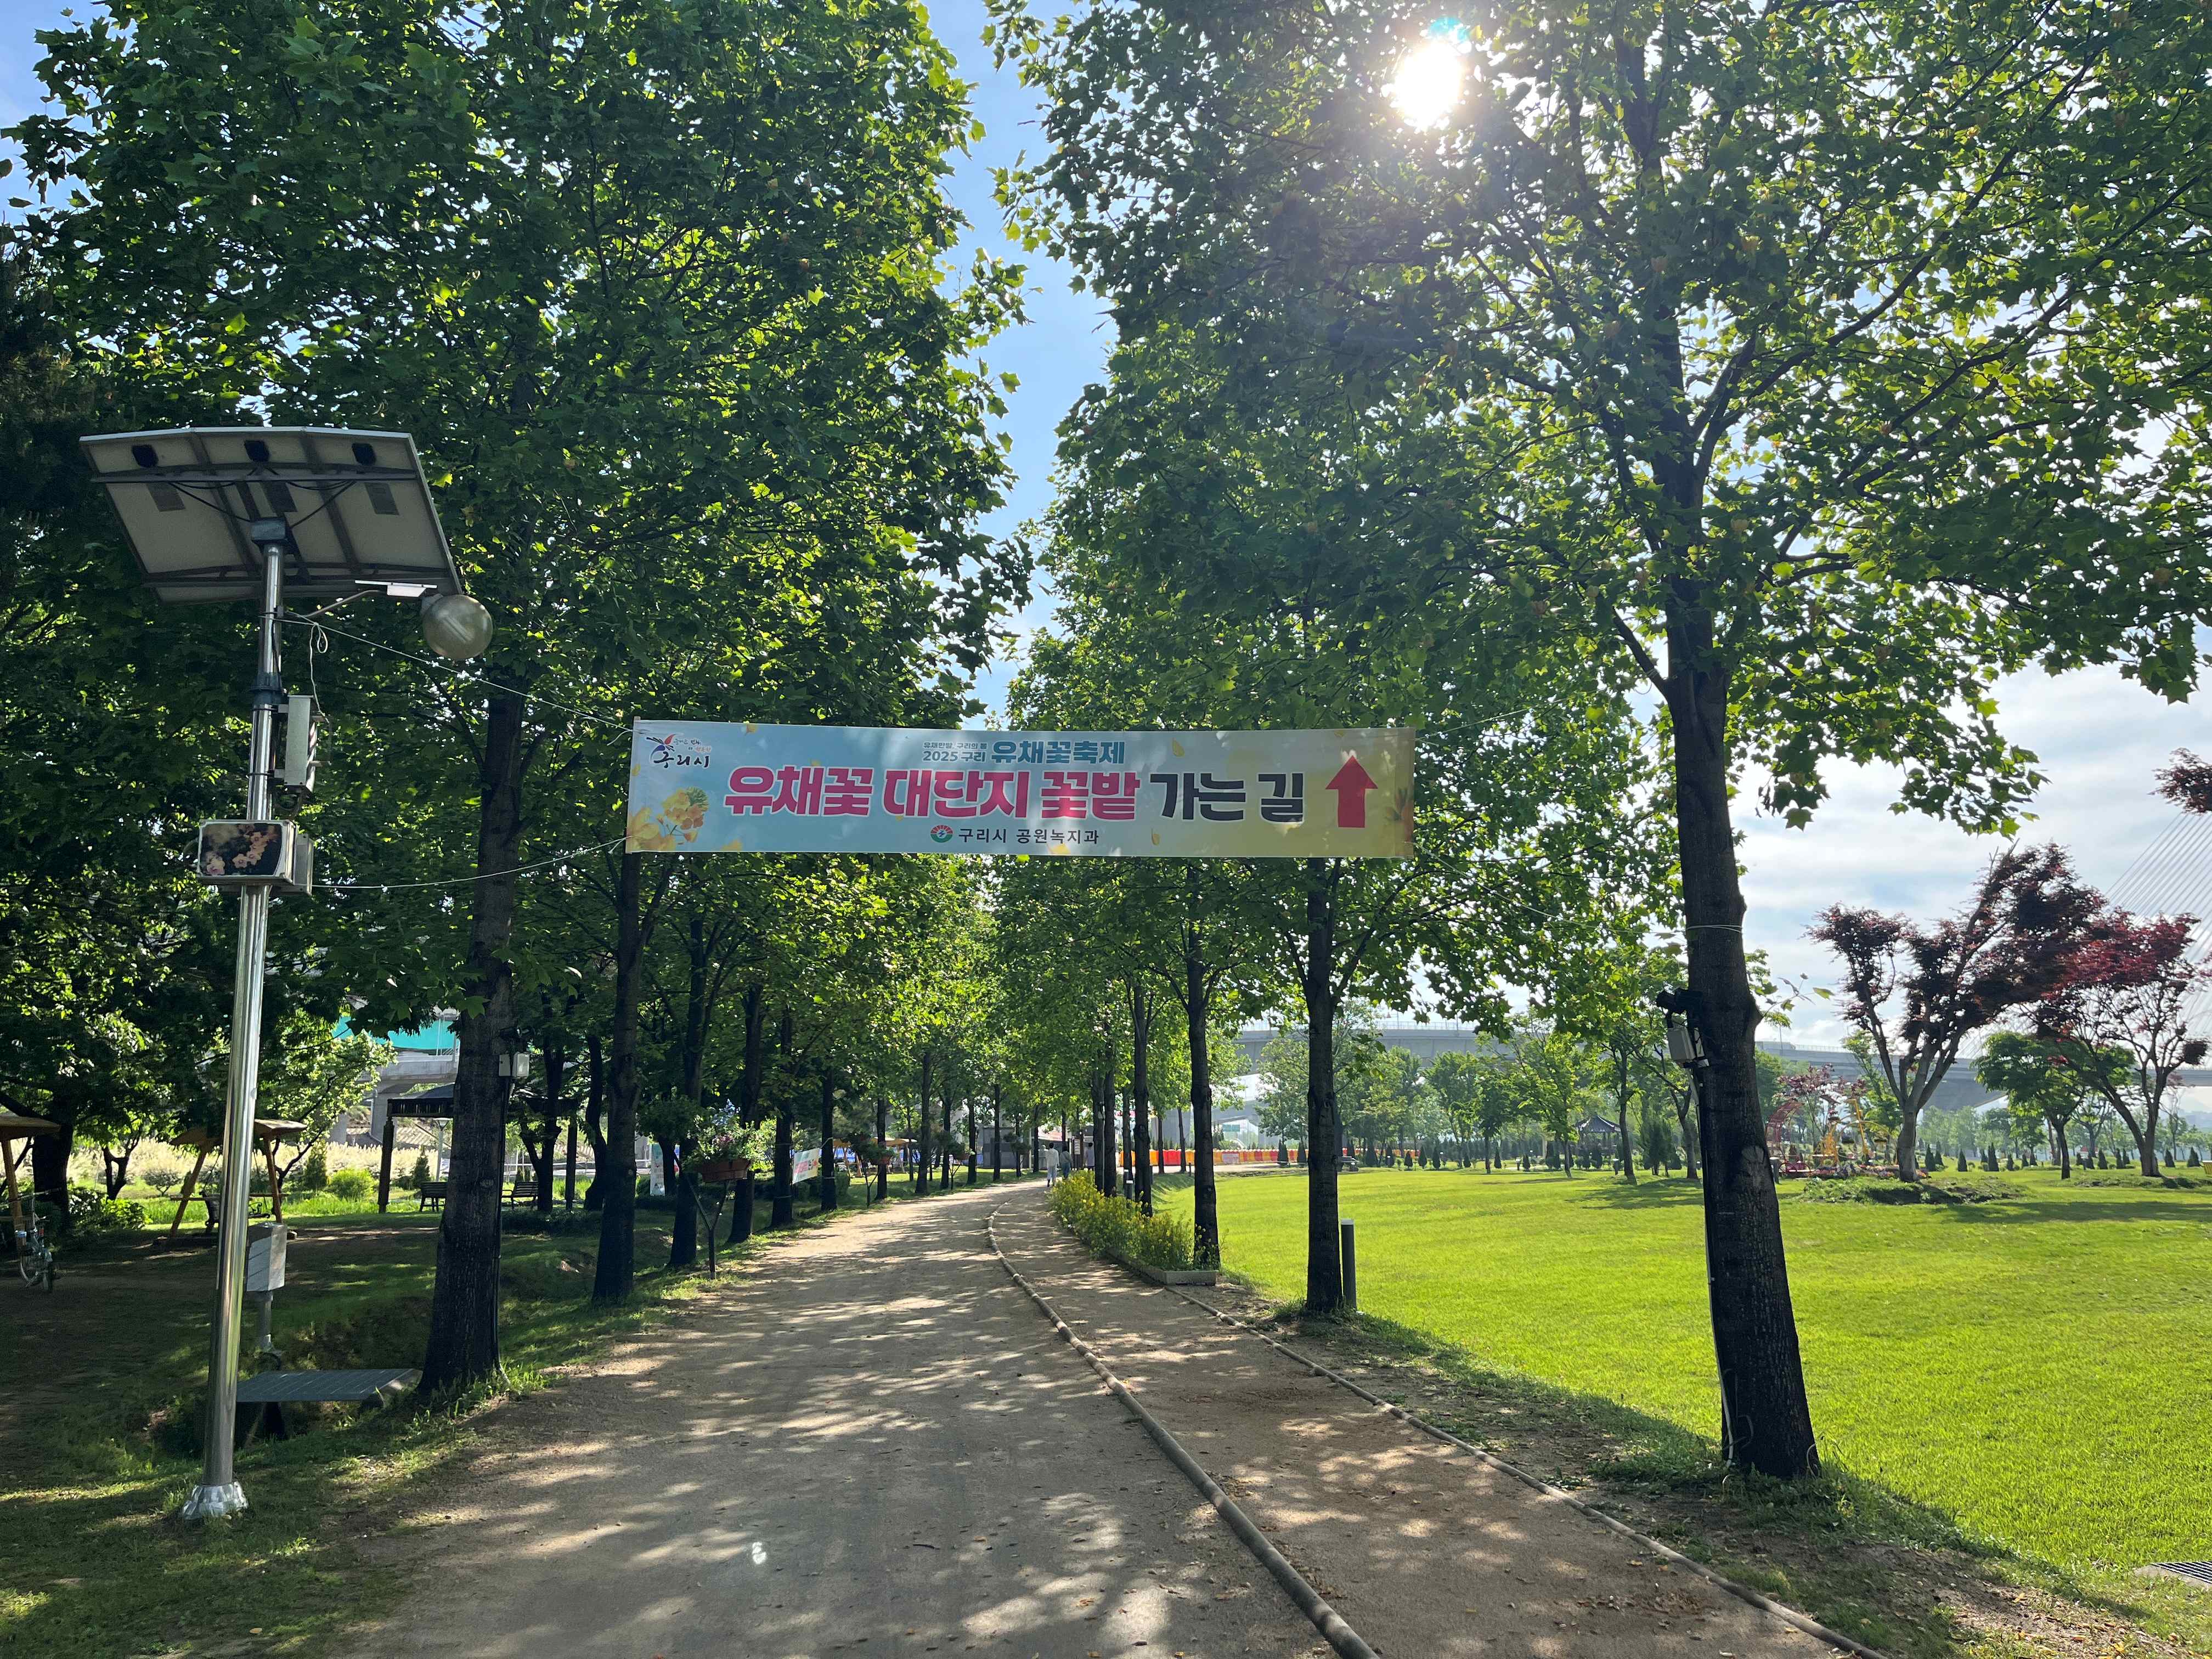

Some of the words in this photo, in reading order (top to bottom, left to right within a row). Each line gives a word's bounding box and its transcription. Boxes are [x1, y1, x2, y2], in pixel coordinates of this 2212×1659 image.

[653, 751, 709, 769] 구리시
[923, 751, 958, 761] 2025
[961, 752, 986, 762] 구리
[991, 741, 1125, 764] 유채꽃축제
[725, 766, 873, 815] 유채꽃
[884, 770, 1030, 817] 대단지
[1041, 771, 1141, 820] 꽃밭
[1150, 773, 1246, 821] 가는
[1258, 773, 1304, 822] 길
[958, 828, 1006, 843] 구리시
[1016, 829, 1099, 844] 공원녹지과
